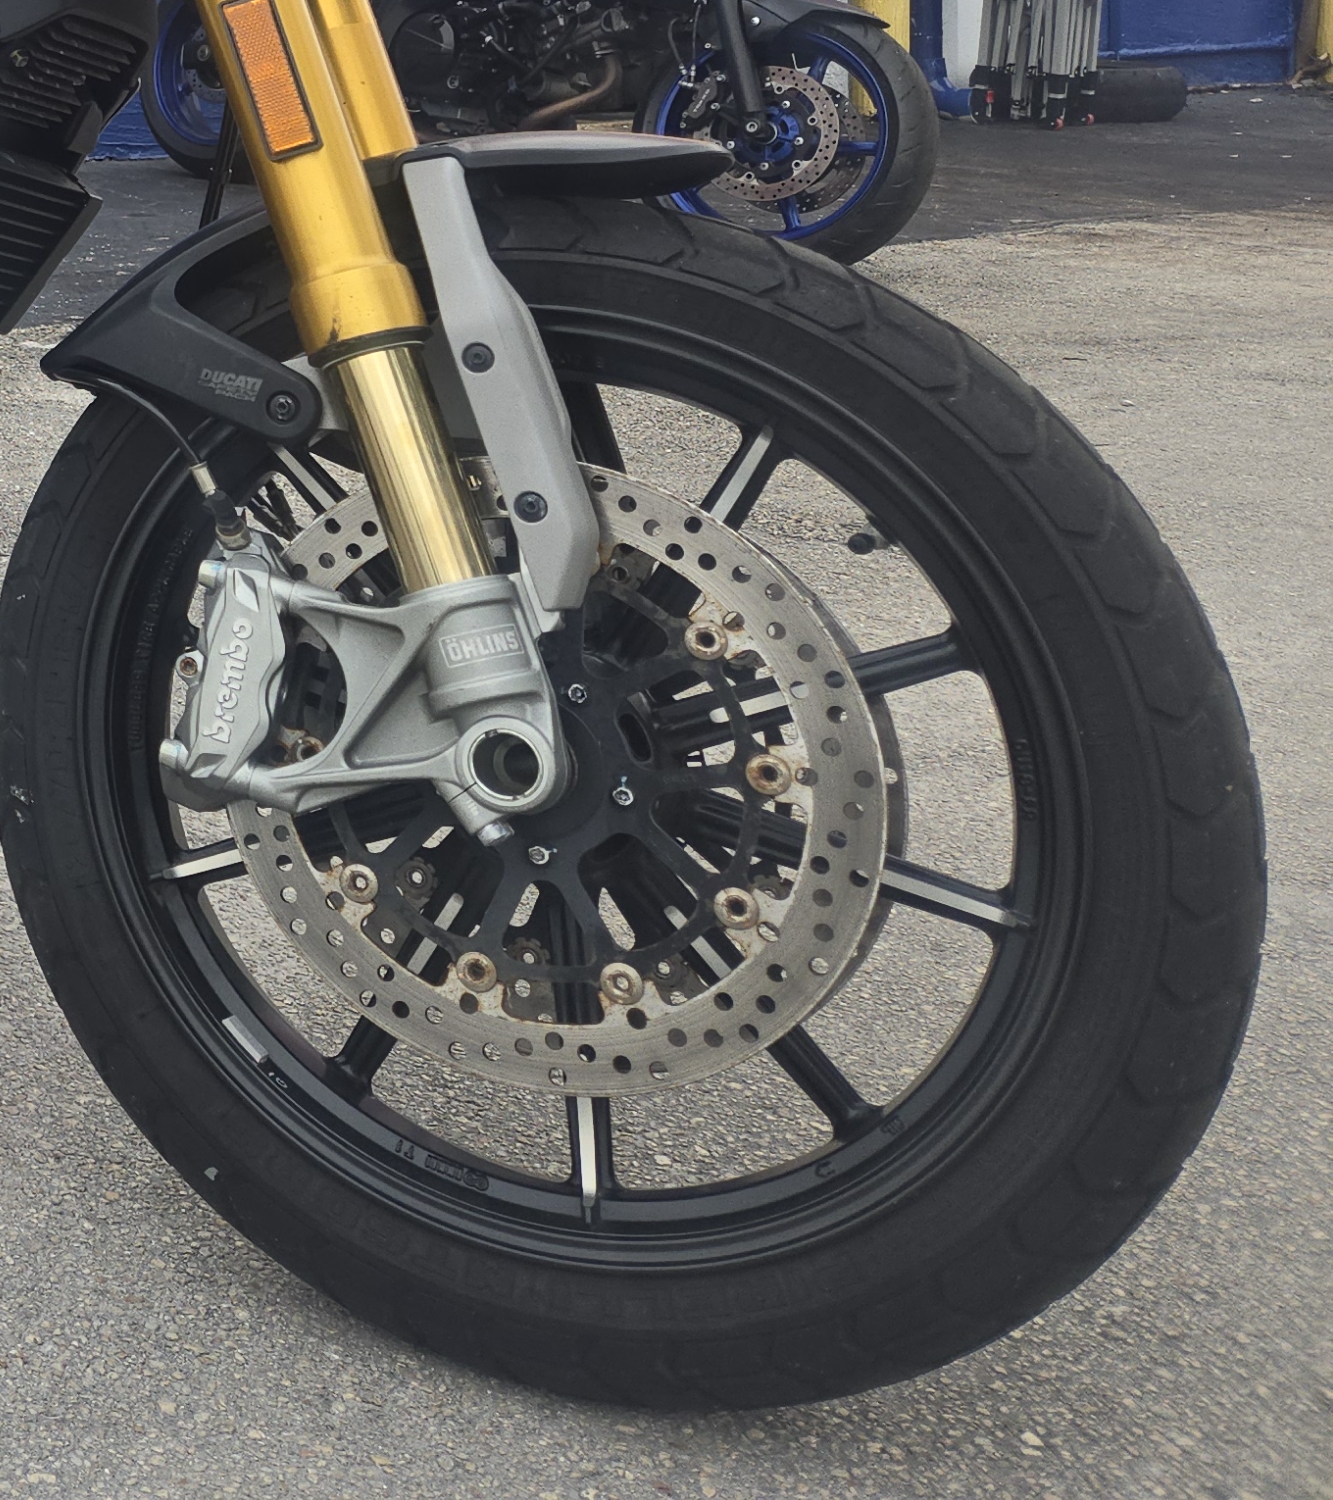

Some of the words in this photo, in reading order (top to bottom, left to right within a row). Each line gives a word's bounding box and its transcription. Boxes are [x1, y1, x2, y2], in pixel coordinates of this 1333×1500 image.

[199, 367, 264, 392] DUCATI
[446, 630, 520, 662] ÖHLINS
[201, 617, 253, 744] brembo
